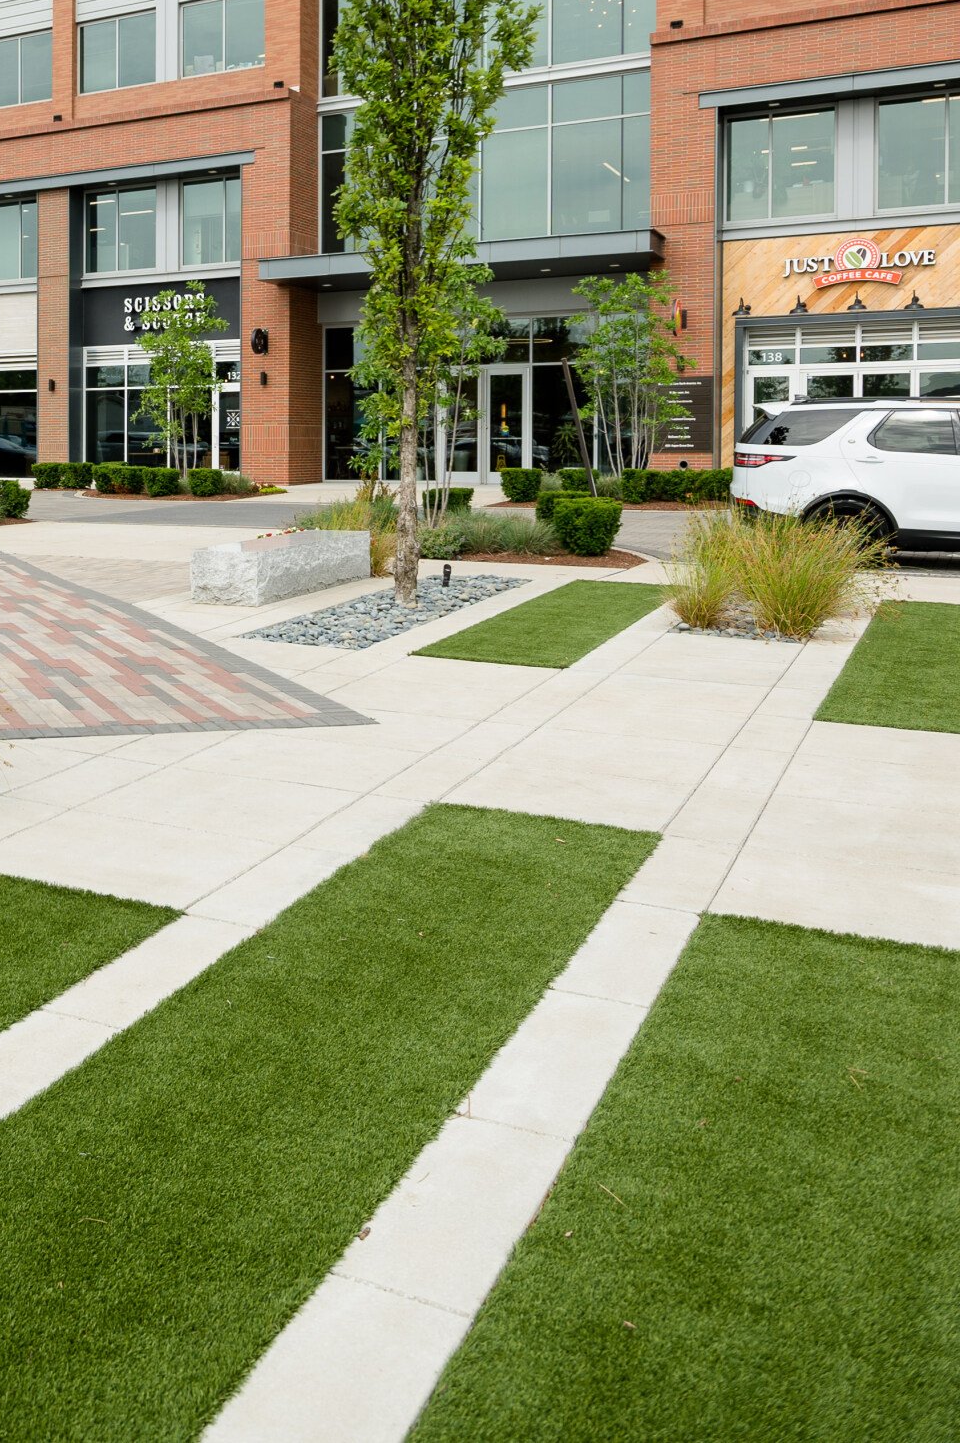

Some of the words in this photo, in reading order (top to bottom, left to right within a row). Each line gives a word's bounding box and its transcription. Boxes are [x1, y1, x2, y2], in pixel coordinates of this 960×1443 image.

[783, 256, 834, 277] JUST
[880, 249, 936, 268] LOVE
[821, 271, 861, 284] COFFEE
[865, 270, 893, 281] CAFE
[124, 293, 205, 313] SCISSORS
[123, 316, 135, 331] &
[761, 352, 783, 362] 138
[227, 371, 240, 380] 132
